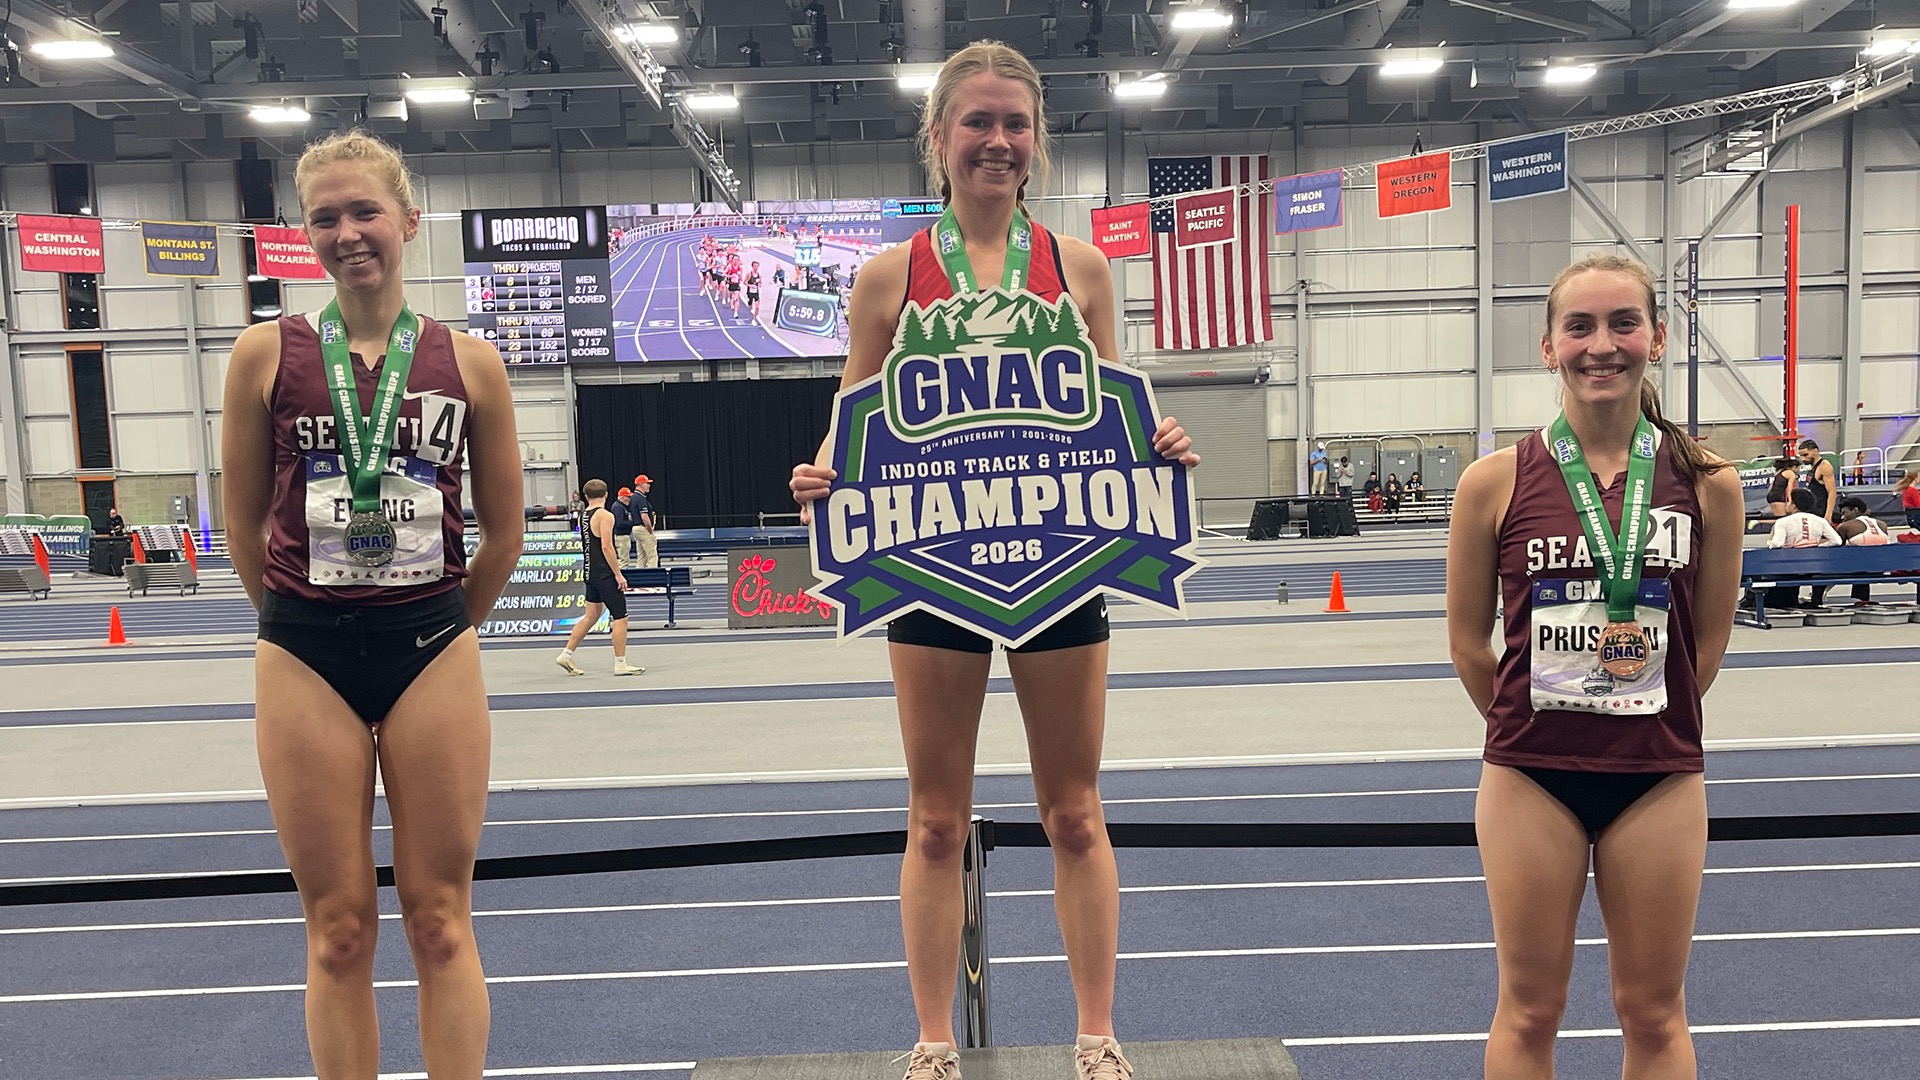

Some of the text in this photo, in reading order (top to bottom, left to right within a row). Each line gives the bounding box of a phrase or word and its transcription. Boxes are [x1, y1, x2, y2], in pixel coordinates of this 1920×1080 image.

[1502, 152, 1552, 169] WESTERN
[1492, 162, 1562, 182] WASHINGTON
[1390, 172, 1437, 187] WESTERN
[1292, 190, 1322, 203] SIMON
[1393, 185, 1435, 199] OREGON
[904, 204, 924, 214] MEN
[1184, 205, 1226, 220] SEATTLE
[1290, 203, 1325, 216] FRASER
[491, 216, 579, 246] BORRACHO
[1109, 220, 1133, 231] SAINT
[1187, 218, 1224, 231] PACIFIC
[35, 233, 88, 244] CENTRAL
[1102, 231, 1140, 243] MARTIN'S
[146, 238, 215, 250] MONTANA ST.
[261, 242, 313, 252] NORTHWES
[502, 244, 523, 252] TACOS
[532, 242, 571, 251] TEQUILERIA
[24, 245, 100, 257] WASHINGTON
[159, 251, 206, 262] BILLINGS
[266, 254, 317, 265] NAZARENE
[493, 263, 560, 273] THRU 2 PROJECTED
[538, 276, 551, 285] 13
[575, 275, 596, 284] MEN
[956, 271, 970, 294] GNAC
[508, 289, 515, 298] 7
[574, 285, 580, 294] 2
[588, 285, 598, 293] 17
[539, 300, 552, 310] 99
[568, 294, 607, 304] SCORED
[789, 305, 825, 321] 5:59.8
[497, 315, 564, 326] THRU 3 PROJECTED
[323, 322, 334, 343] GNAC
[507, 328, 520, 339] 31
[541, 327, 554, 338] 69
[571, 328, 607, 337] WOMEN
[401, 331, 414, 352] GNAC
[508, 340, 558, 351] 23 152
[578, 338, 584, 347] 3
[591, 338, 601, 346] 17
[509, 352, 559, 363] 19 173
[571, 347, 609, 357] SCORED
[898, 349, 1085, 426] GNAC
[334, 364, 362, 468] GNAC CHAMPIONSHIPS
[367, 370, 400, 472] GNAC CHAMPIONSHIPS
[429, 402, 456, 462] 4
[920, 430, 1073, 455] 25TH ANNIVERSARY 2001-2026
[1643, 435, 1653, 457] GNAC
[1556, 439, 1571, 462] GNAC
[880, 448, 1117, 481] INDOOR TRACK & FIELD
[334, 498, 415, 523] ENG
[828, 466, 1178, 564] CHAMPION
[46, 525, 84, 533] BILLINGS
[1576, 482, 1615, 580] GNAC CHAMPIONSHIPS
[1622, 479, 1645, 580] GNAC CHAMPIONSHIPS
[41, 535, 80, 543] AZARENE
[1645, 513, 1677, 559] 21
[350, 535, 392, 551] GNAC
[523, 541, 555, 551] TEKPERE
[970, 539, 1043, 566] 2026
[516, 557, 577, 568] ONG JUMP
[555, 570, 573, 582] 18'
[1565, 580, 1606, 601] GN
[520, 596, 553, 609] HINTON
[556, 595, 575, 608] 18'
[494, 619, 554, 634] DIXSON
[1539, 625, 1659, 651] PRUSN
[1603, 644, 1645, 660] GNAC
